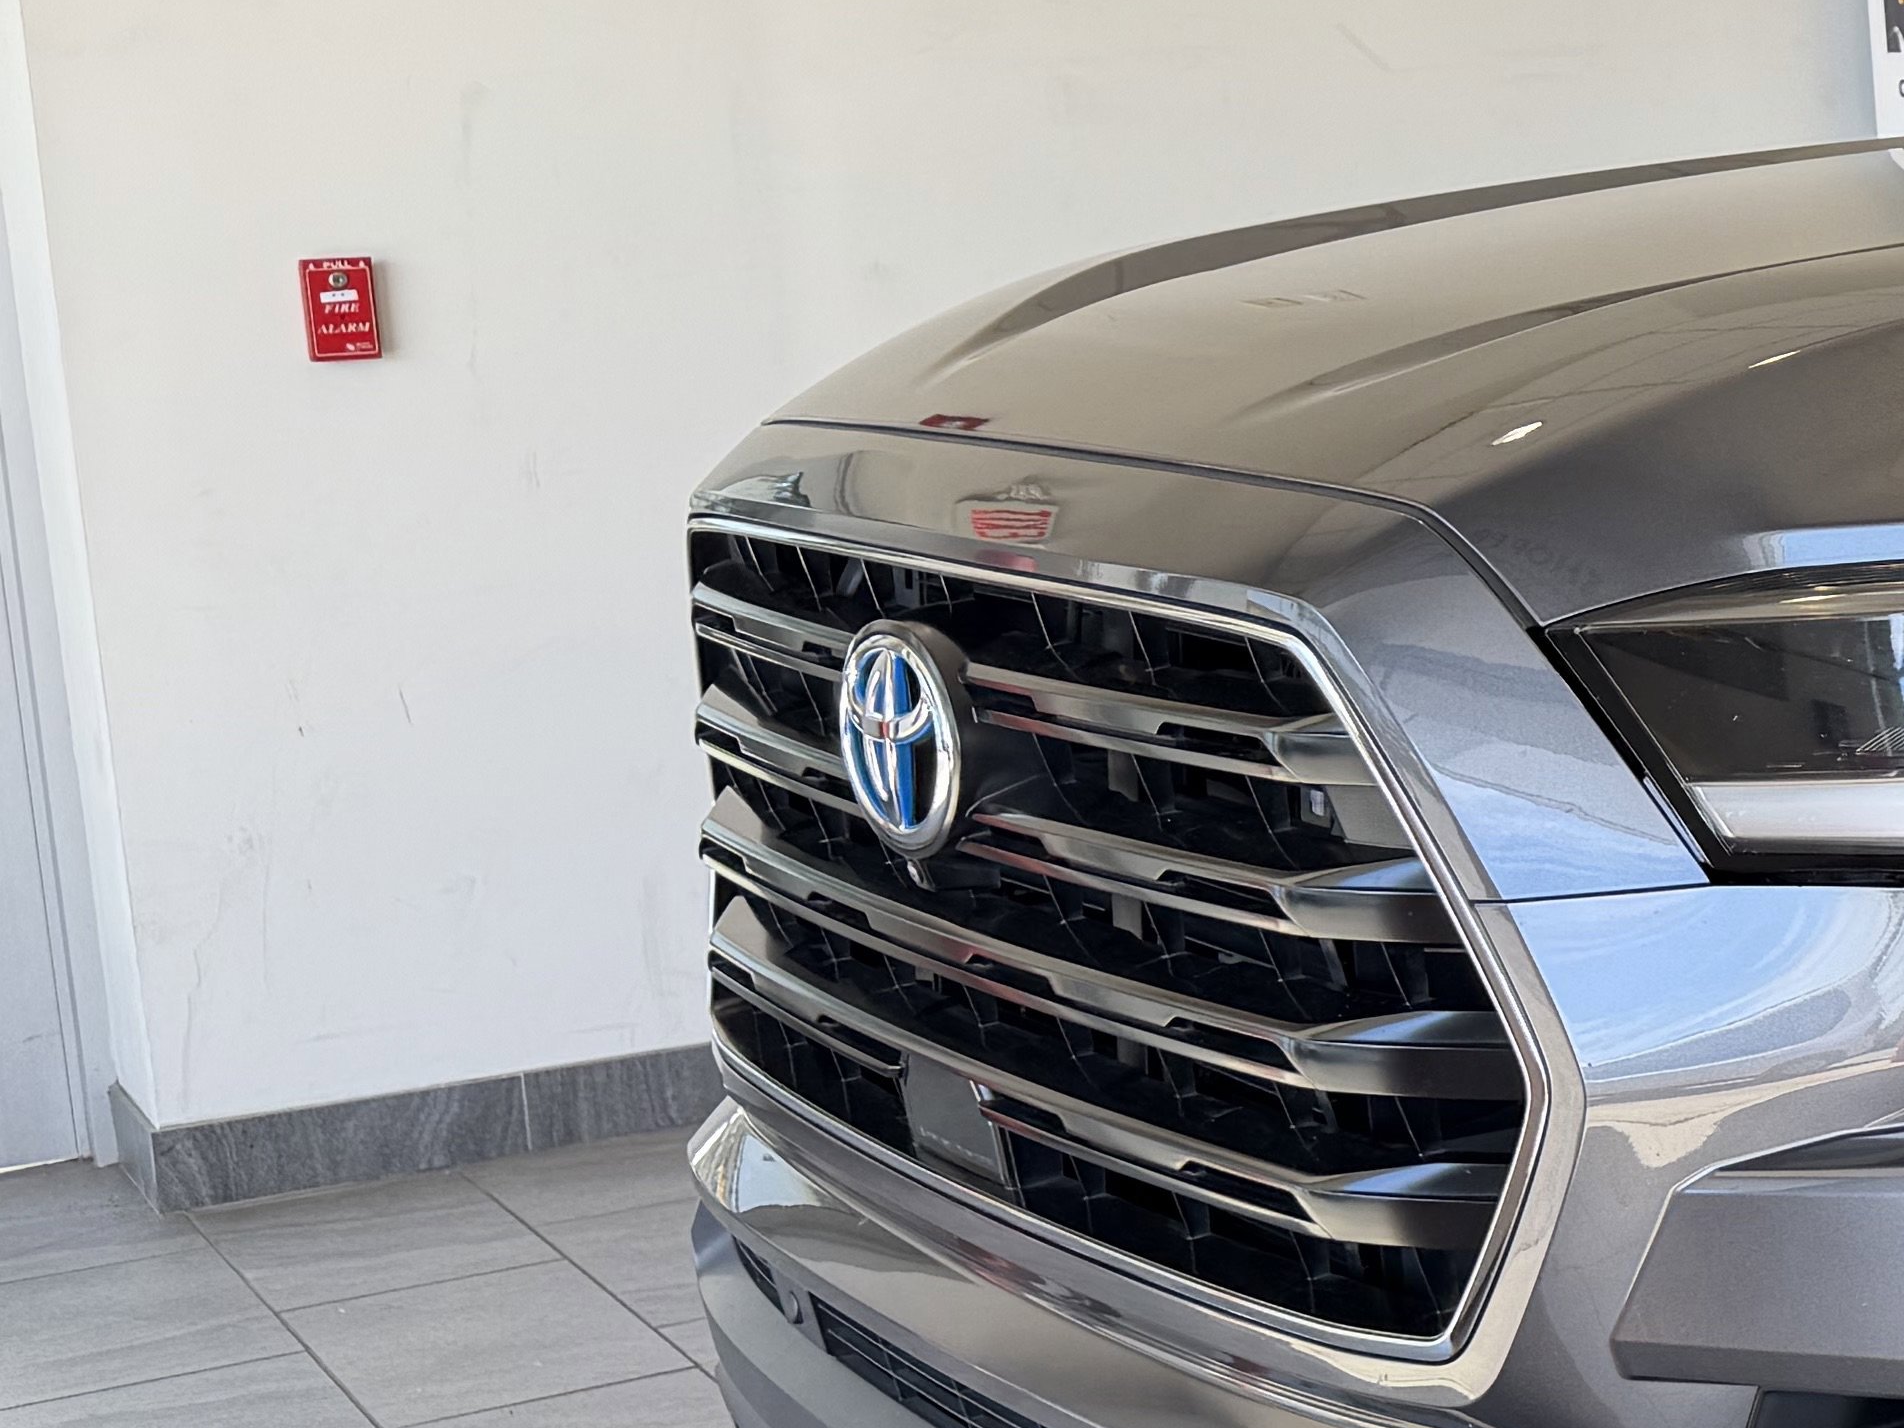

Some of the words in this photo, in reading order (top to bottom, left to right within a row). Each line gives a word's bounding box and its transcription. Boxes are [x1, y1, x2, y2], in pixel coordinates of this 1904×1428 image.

[322, 260, 353, 270] PULL
[325, 303, 360, 314] FIRE
[318, 322, 370, 334] ALARM
